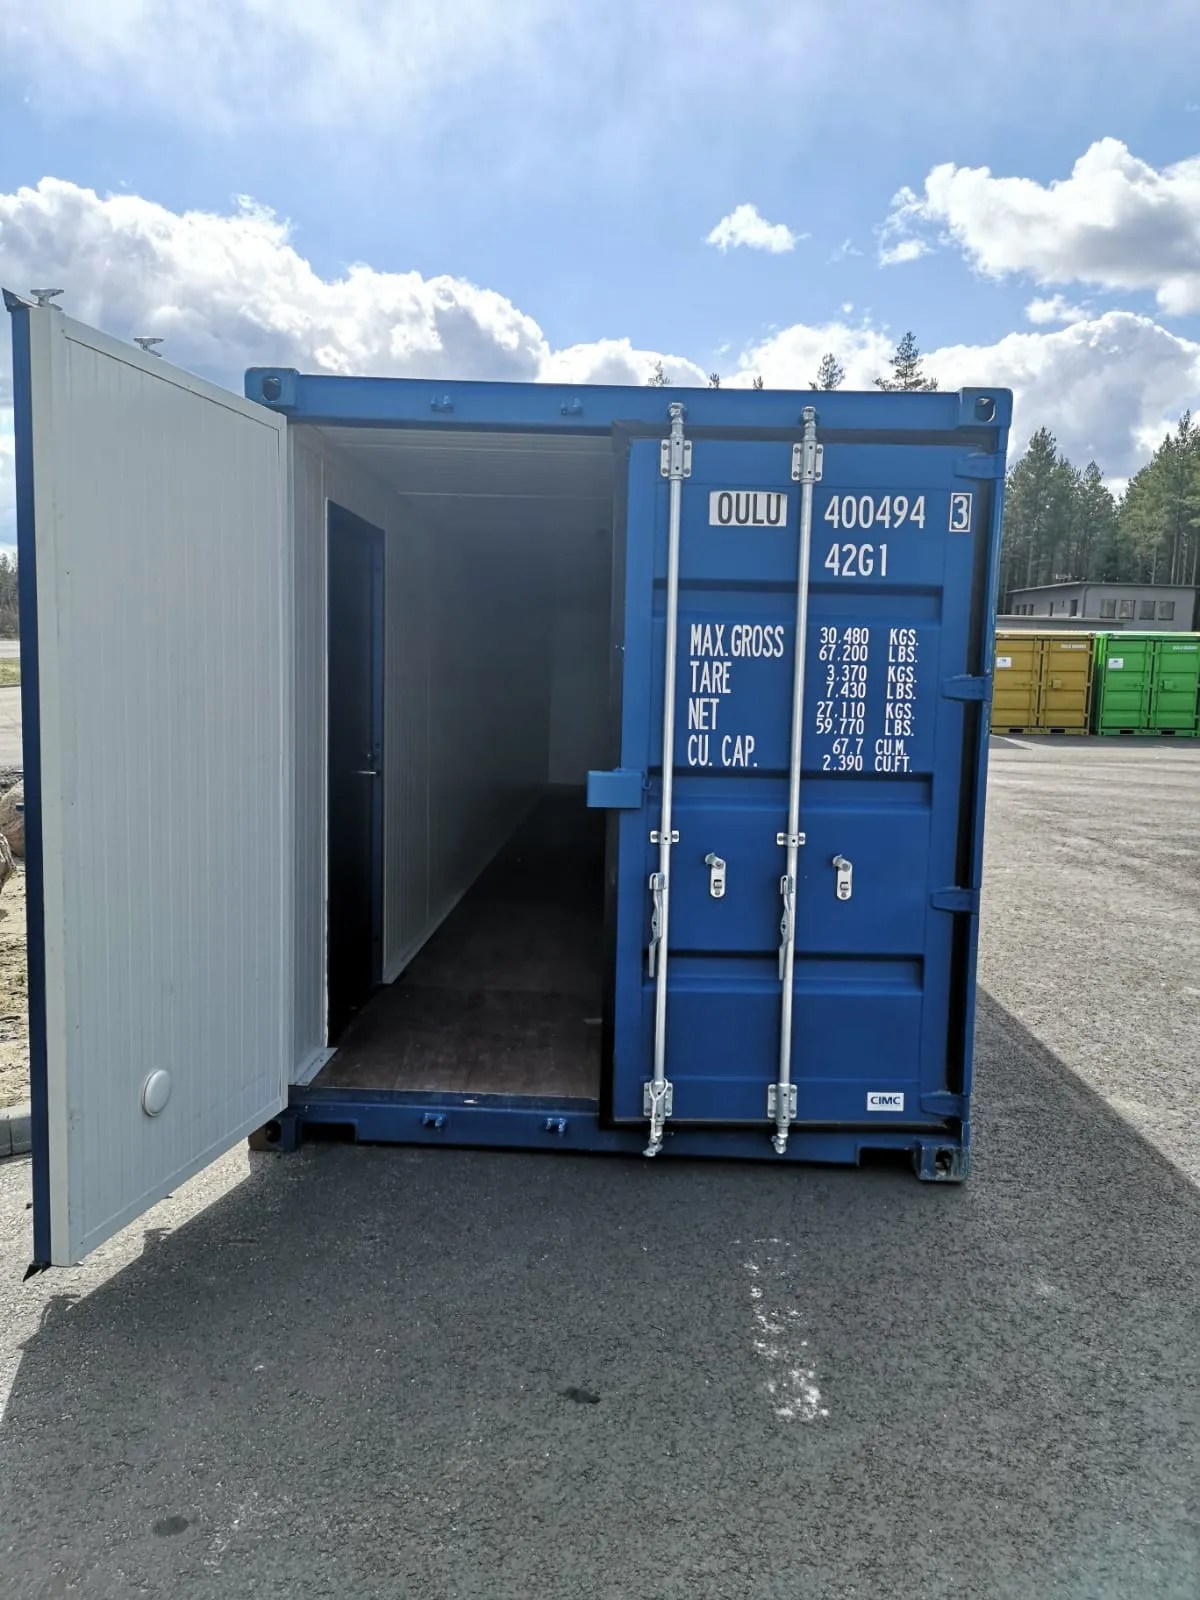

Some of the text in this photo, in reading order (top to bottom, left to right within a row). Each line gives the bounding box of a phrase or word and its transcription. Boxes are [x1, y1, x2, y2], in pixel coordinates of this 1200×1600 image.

[717, 492, 968, 529] OULU 400494 3
[824, 543, 887, 577] 42G1
[889, 628, 919, 646] KGS.
[888, 645, 918, 663] LBS.
[689, 660, 732, 694] TARE
[887, 665, 917, 683] KGS.
[886, 682, 916, 700] LBS.
[687, 697, 720, 730] NET
[885, 702, 915, 720] KGS.
[884, 719, 914, 737] LBS.
[687, 734, 713, 767] CU.
[721, 735, 758, 768] CAP.
[870, 1096, 901, 1105] CIMC
